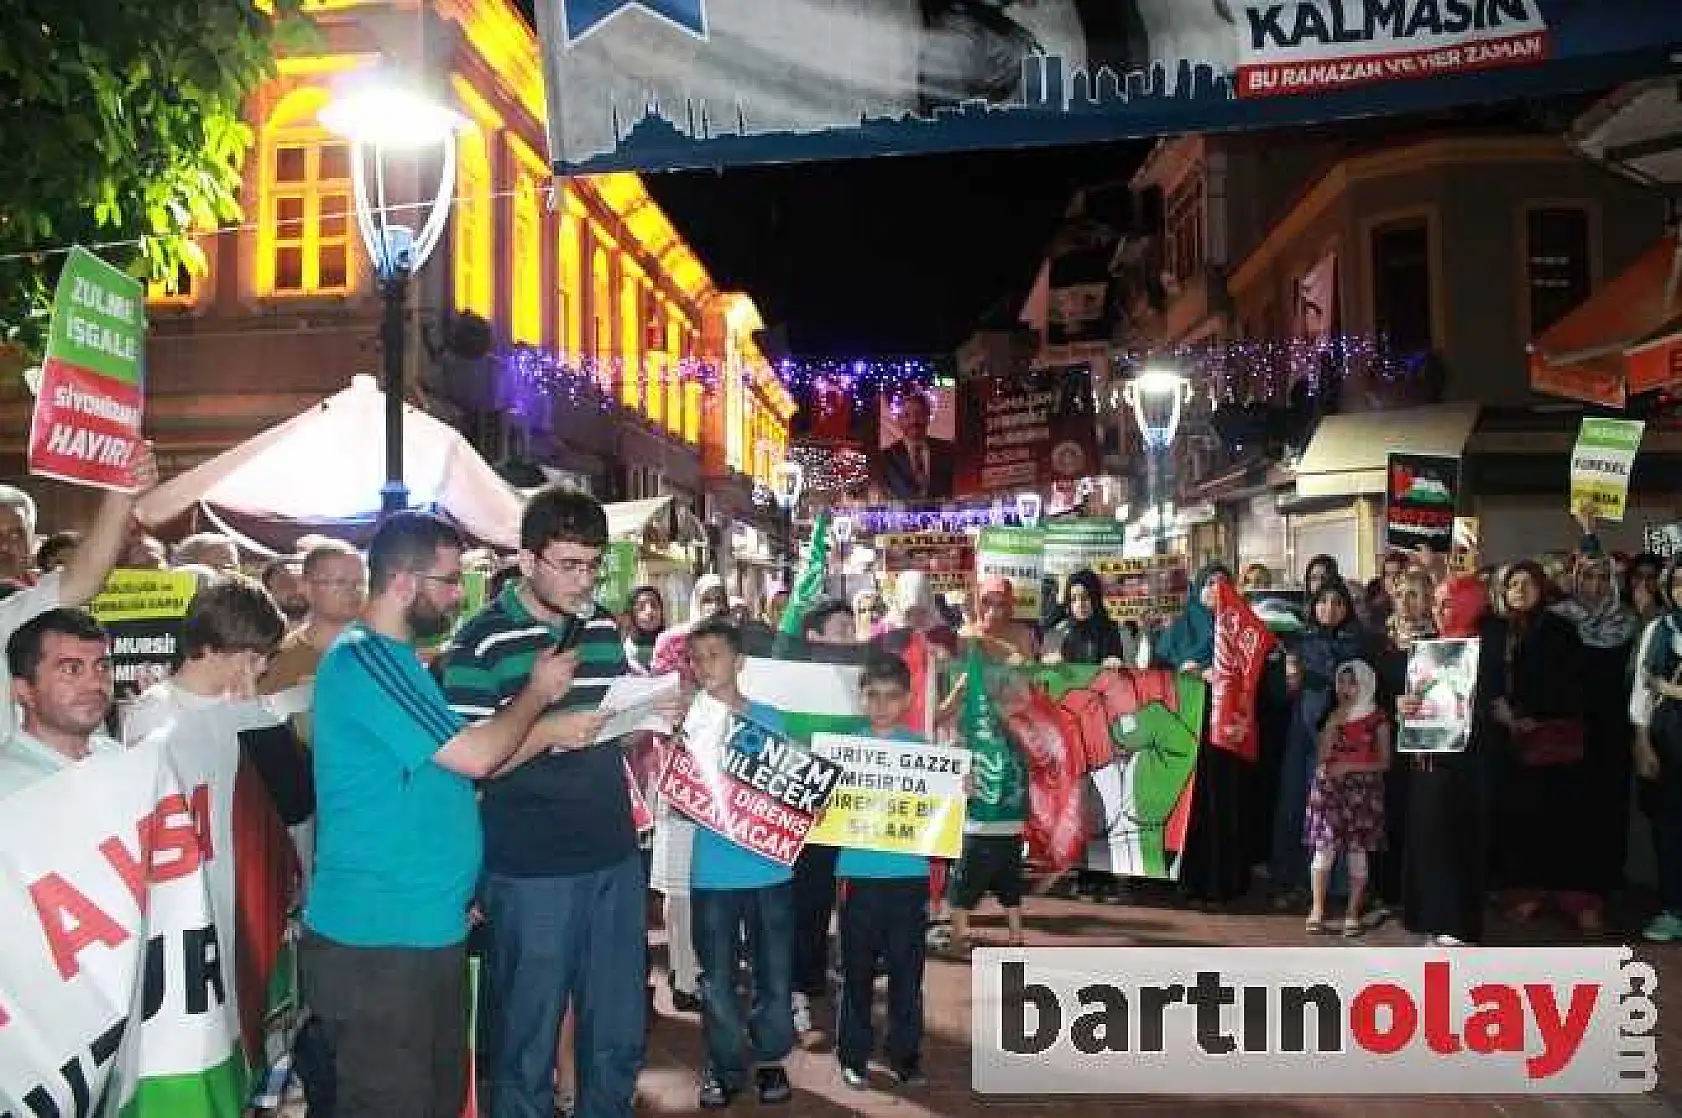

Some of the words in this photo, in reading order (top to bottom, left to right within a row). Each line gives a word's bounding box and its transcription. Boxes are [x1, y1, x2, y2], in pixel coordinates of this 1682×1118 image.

[1248, 69, 1277, 90] BU
[1281, 60, 1383, 87] RAMAZAN
[1384, 57, 1417, 74] VE
[1463, 37, 1542, 64] ZAMAN
[899, 753, 962, 775] GAZZE
